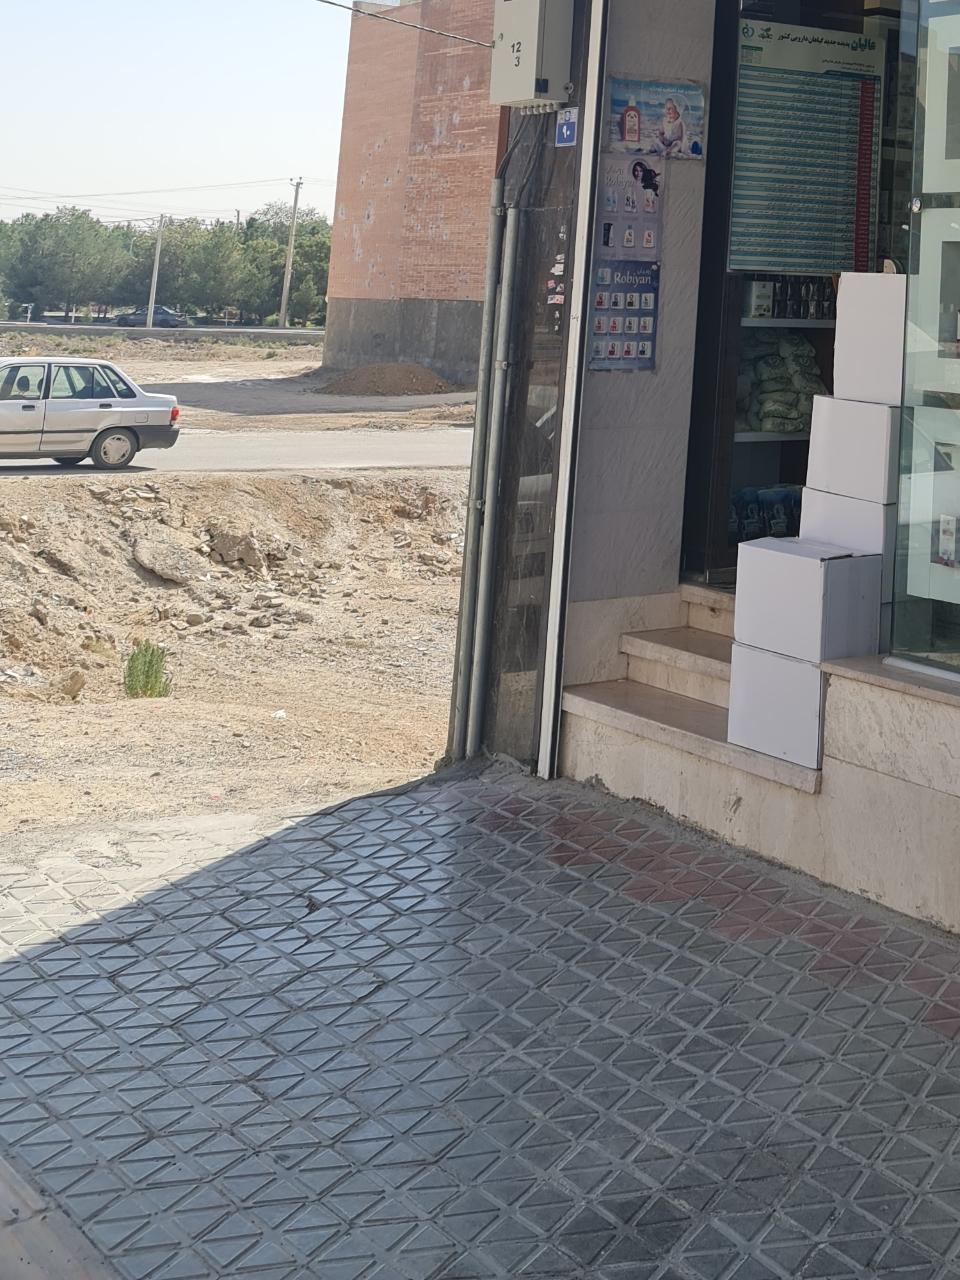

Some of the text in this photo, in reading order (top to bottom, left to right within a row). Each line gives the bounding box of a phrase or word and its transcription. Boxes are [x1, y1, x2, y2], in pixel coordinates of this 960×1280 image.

[510, 41, 522, 54] 12
[514, 56, 521, 68] 3
[614, 271, 652, 287] Robiyan
